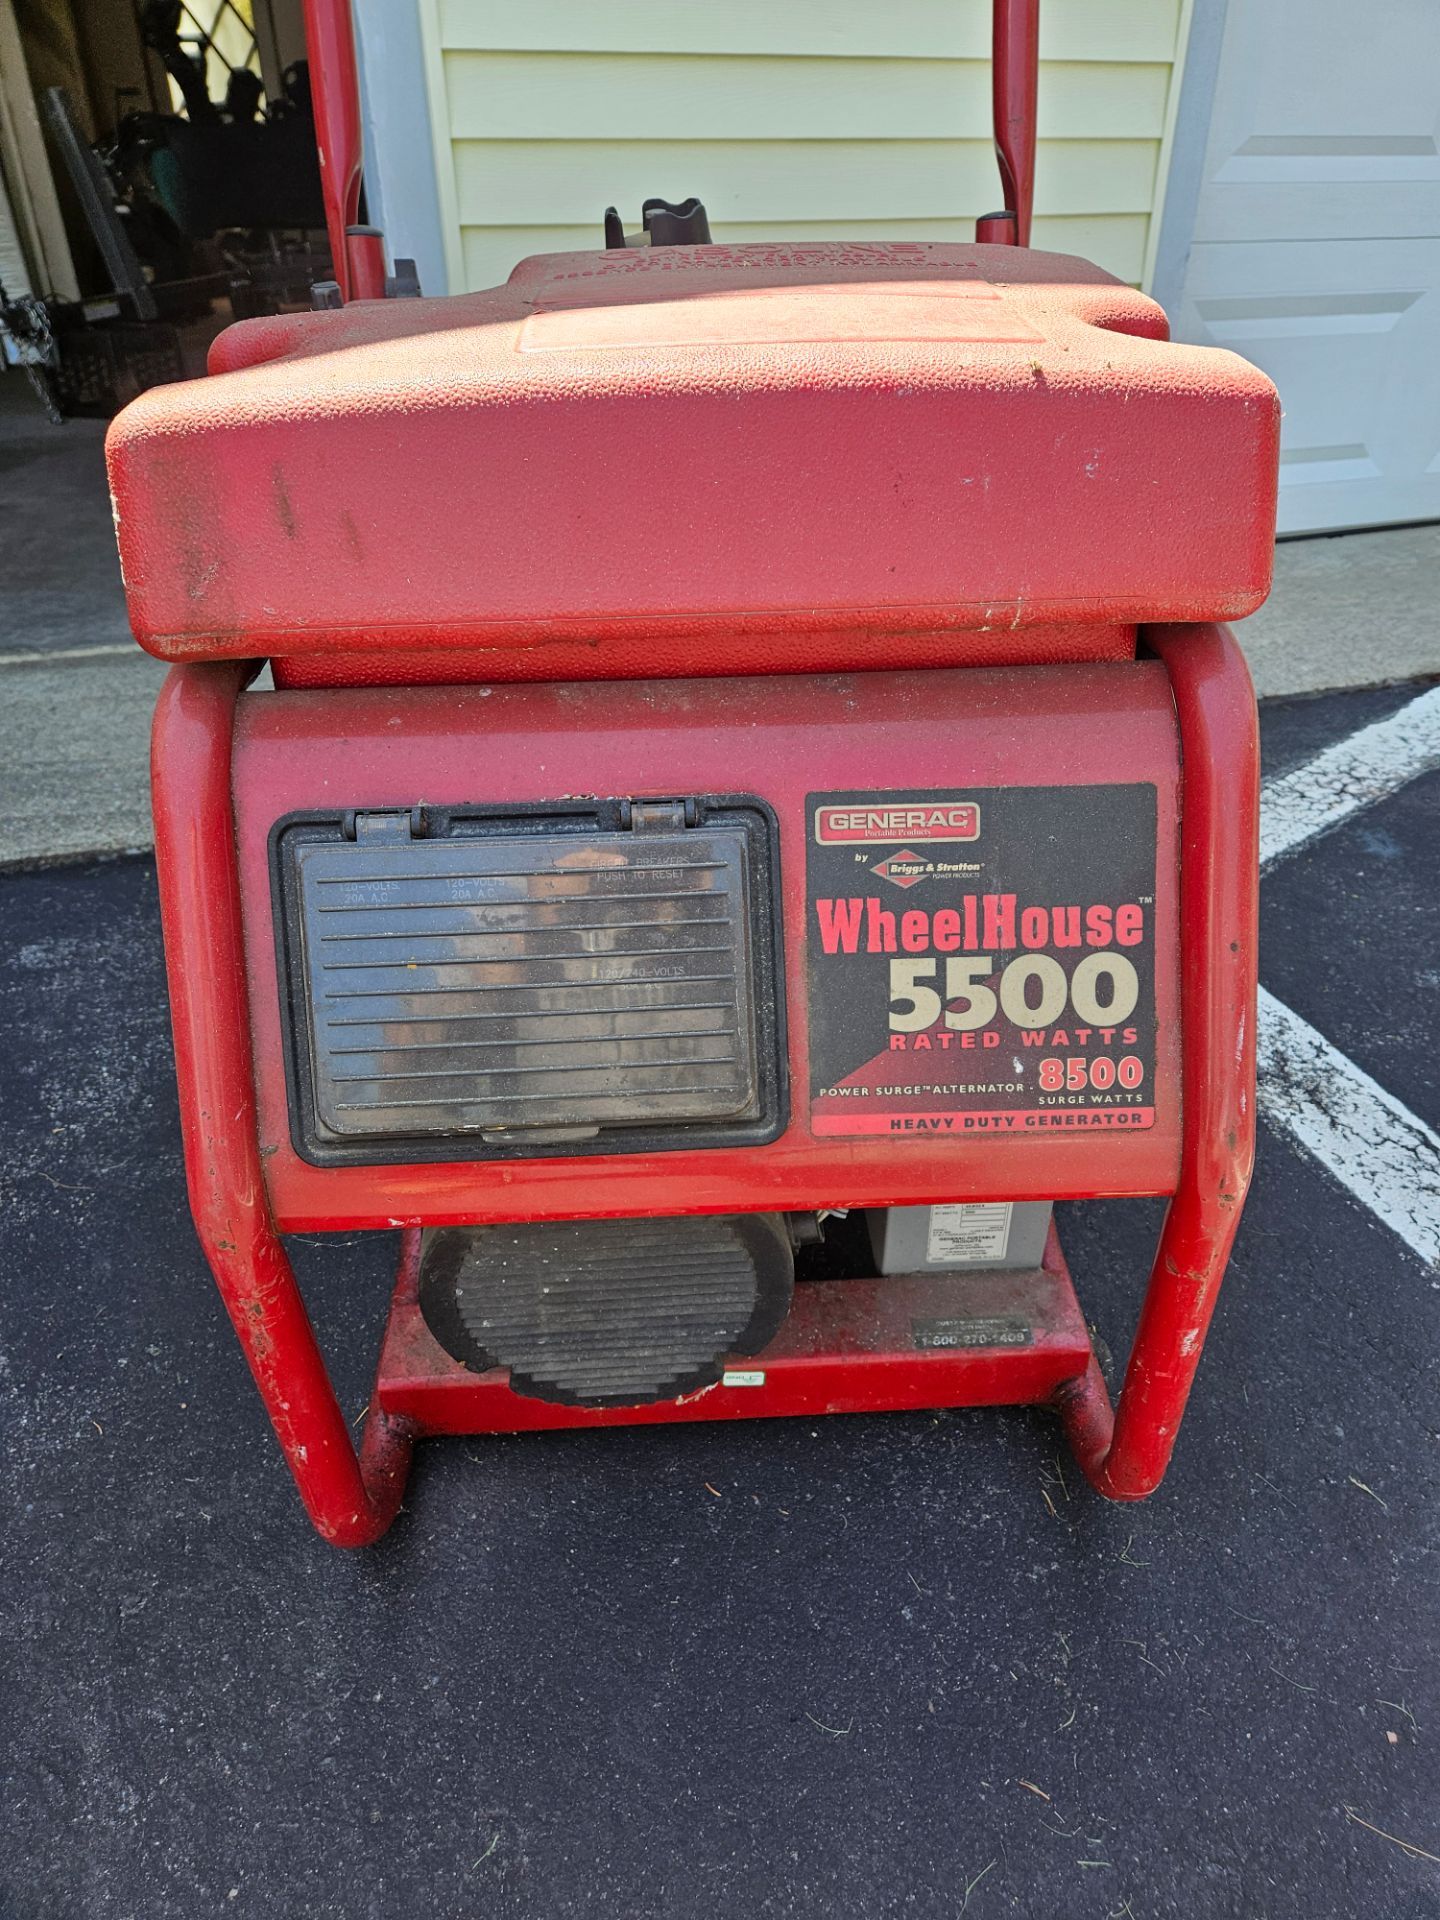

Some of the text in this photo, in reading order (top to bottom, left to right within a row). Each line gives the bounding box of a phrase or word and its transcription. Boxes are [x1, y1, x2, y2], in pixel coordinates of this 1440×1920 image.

[828, 810, 968, 830] GENERAC
[864, 828, 932, 837] Portable Products
[854, 853, 869, 863] by
[652, 869, 685, 880] RESET
[890, 862, 981, 875] Briggs & Stratton
[446, 876, 505, 888] 120-VOLTS
[451, 889, 472, 899] 20A
[816, 894, 1144, 954] WheelHouse
[889, 952, 1139, 1033] 5500
[890, 1027, 1138, 1050] RATED WATTS
[1039, 1055, 1144, 1092] 8500
[820, 1087, 870, 1097] POWER
[932, 1083, 1024, 1095] ALTERNATOR
[1039, 1094, 1143, 1105] SURGE WATTS
[890, 1113, 1143, 1130] HEAVY DUTY GENERATOR
